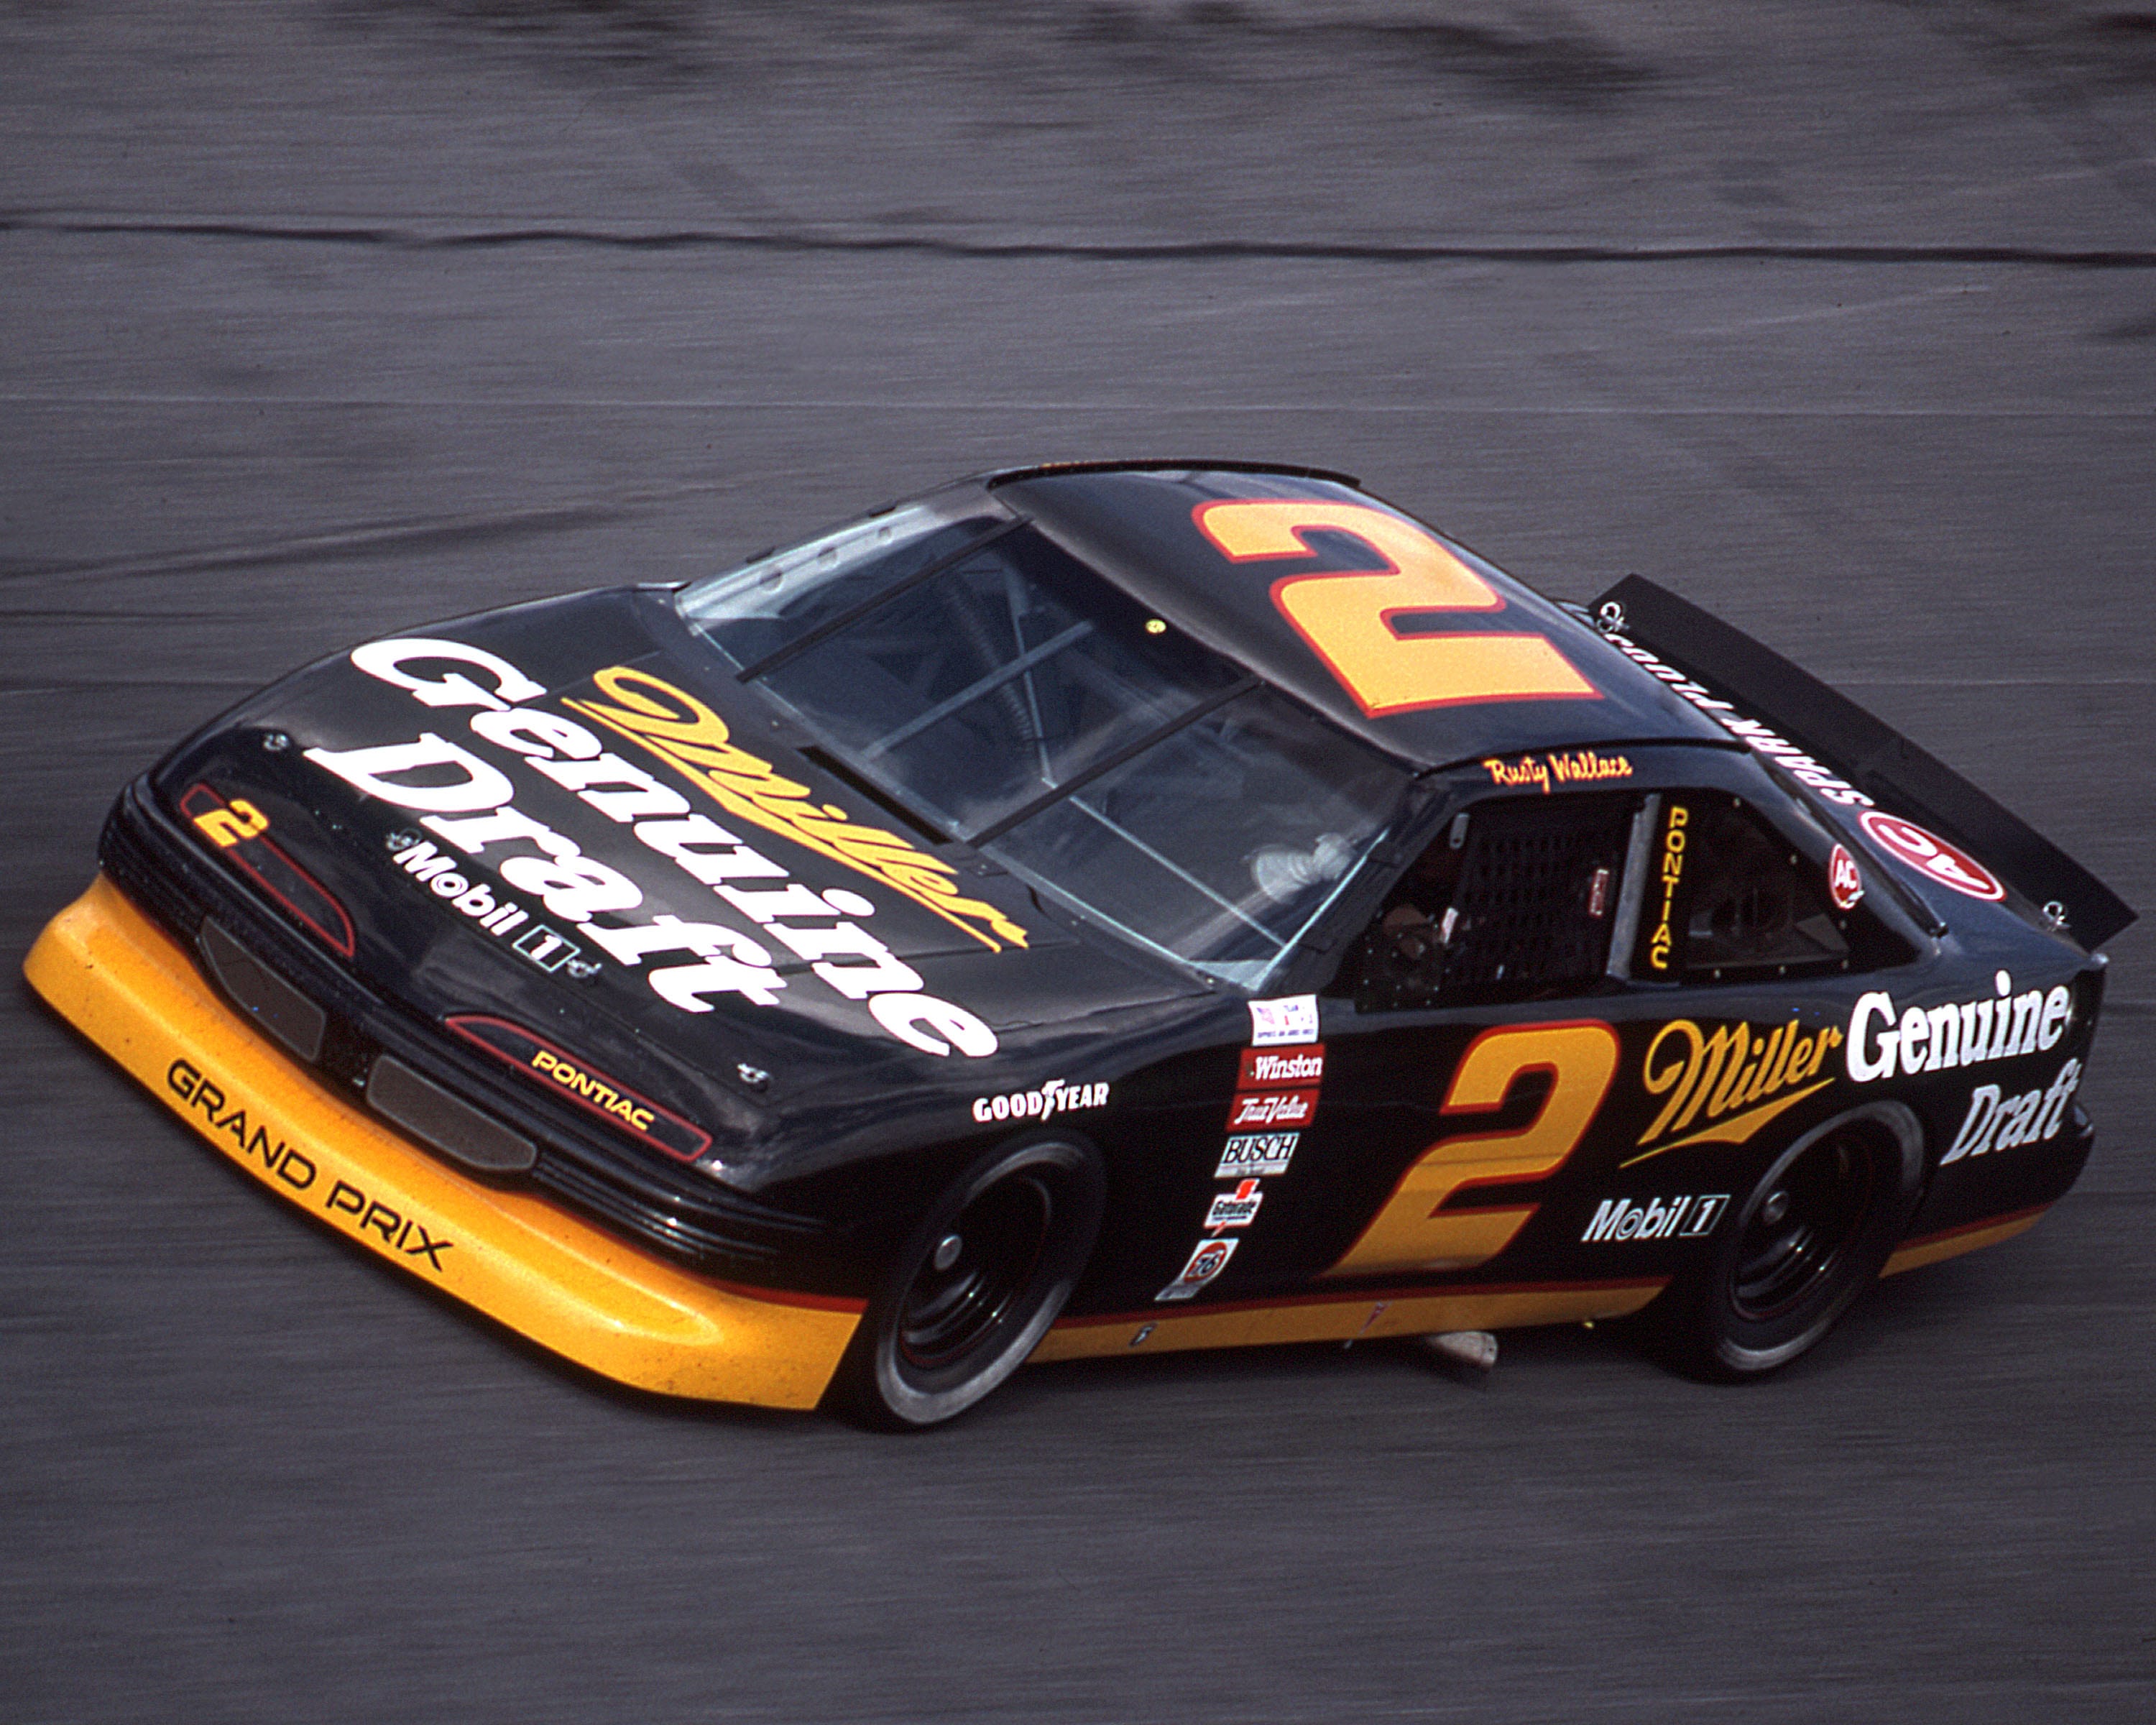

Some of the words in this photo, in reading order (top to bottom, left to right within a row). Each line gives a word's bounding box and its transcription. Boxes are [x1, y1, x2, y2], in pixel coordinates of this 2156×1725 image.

[1192, 499, 1605, 719] 2
[577, 666, 1028, 949] Miller
[1483, 756, 1551, 795] Rusty
[1547, 750, 1634, 784] Wallace
[1720, 718, 1876, 806] SPARK
[194, 799, 269, 847] 2
[351, 638, 998, 1057] Genuine
[1878, 824, 1991, 891] AC
[303, 732, 787, 1013] Draft
[393, 841, 529, 936] Mobil
[1651, 806, 1689, 970] PONTIAC
[1835, 859, 1858, 890] AC
[1256, 1054, 1323, 1080] Winston
[1846, 970, 2073, 1082] Genuine
[532, 1050, 655, 1132] PONTIAC
[973, 1078, 1110, 1123] GOODYEAR
[1637, 1019, 1843, 1146] Miller
[1940, 1058, 2083, 1166] Draft
[167, 1059, 317, 1191] GRAND
[325, 1181, 453, 1272] PRIX
[1224, 1135, 1295, 1164] BUSCH
[1307, 1018, 1621, 1279] 2
[1188, 1249, 1225, 1278] 76
[1581, 1195, 1691, 1242] Mobil
